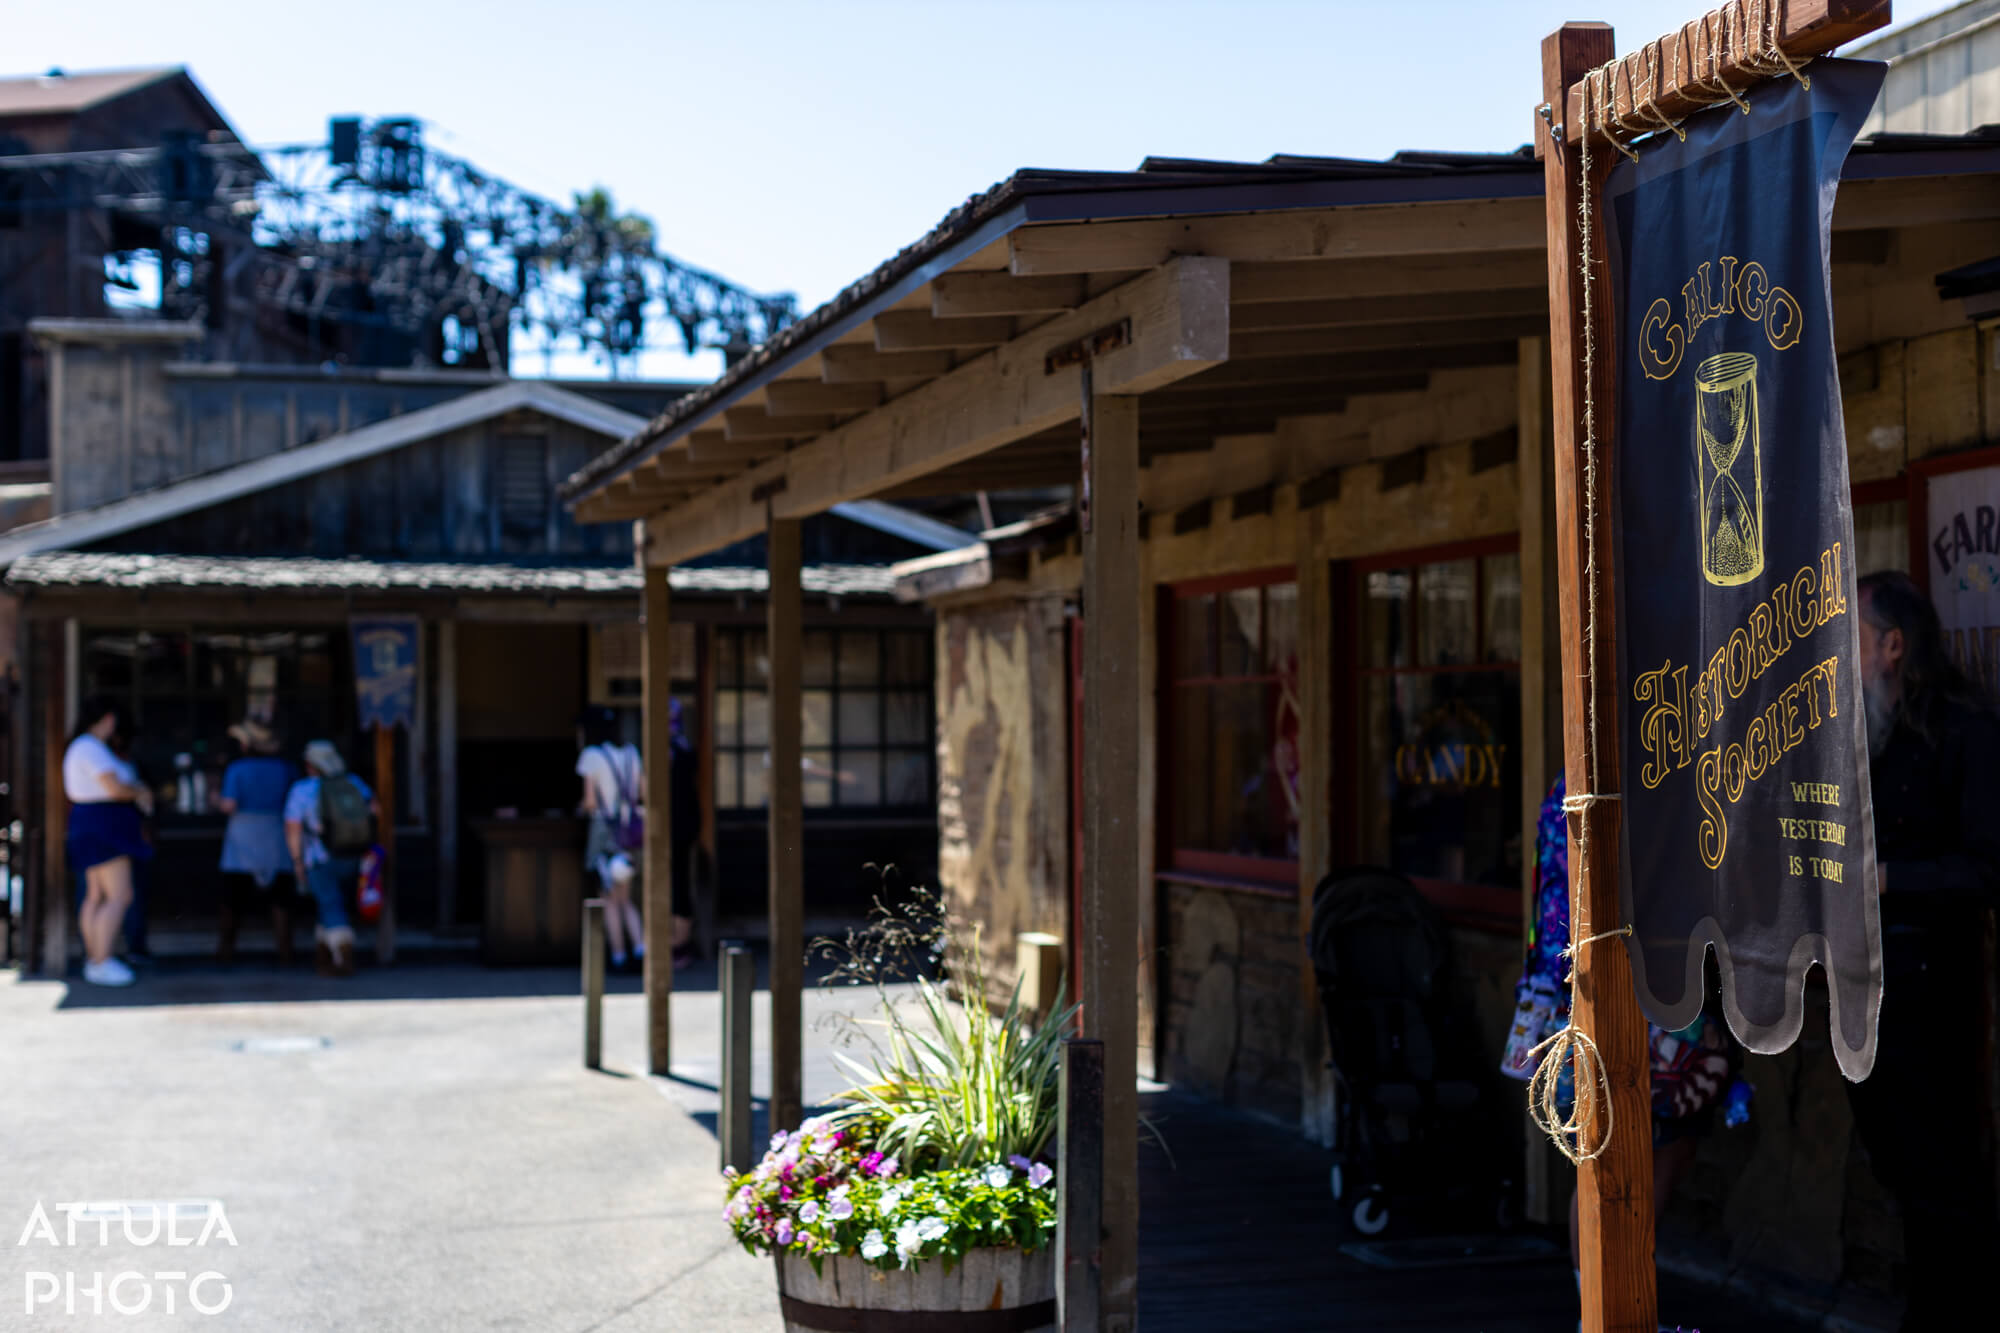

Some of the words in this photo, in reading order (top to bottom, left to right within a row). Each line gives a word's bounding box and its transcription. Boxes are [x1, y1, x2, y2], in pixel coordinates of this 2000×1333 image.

[1639, 256, 1803, 380] CALICO
[1934, 506, 2000, 575] FAR
[1633, 542, 1847, 789] HISTORICAL
[1395, 743, 1508, 790] CANDY
[1696, 656, 1839, 870] SOCIETY
[1790, 782, 1840, 807] WHERE
[1778, 817, 1846, 846] YESTERDAY
[1789, 855, 1803, 876] IS
[1809, 857, 1844, 883] TODAY
